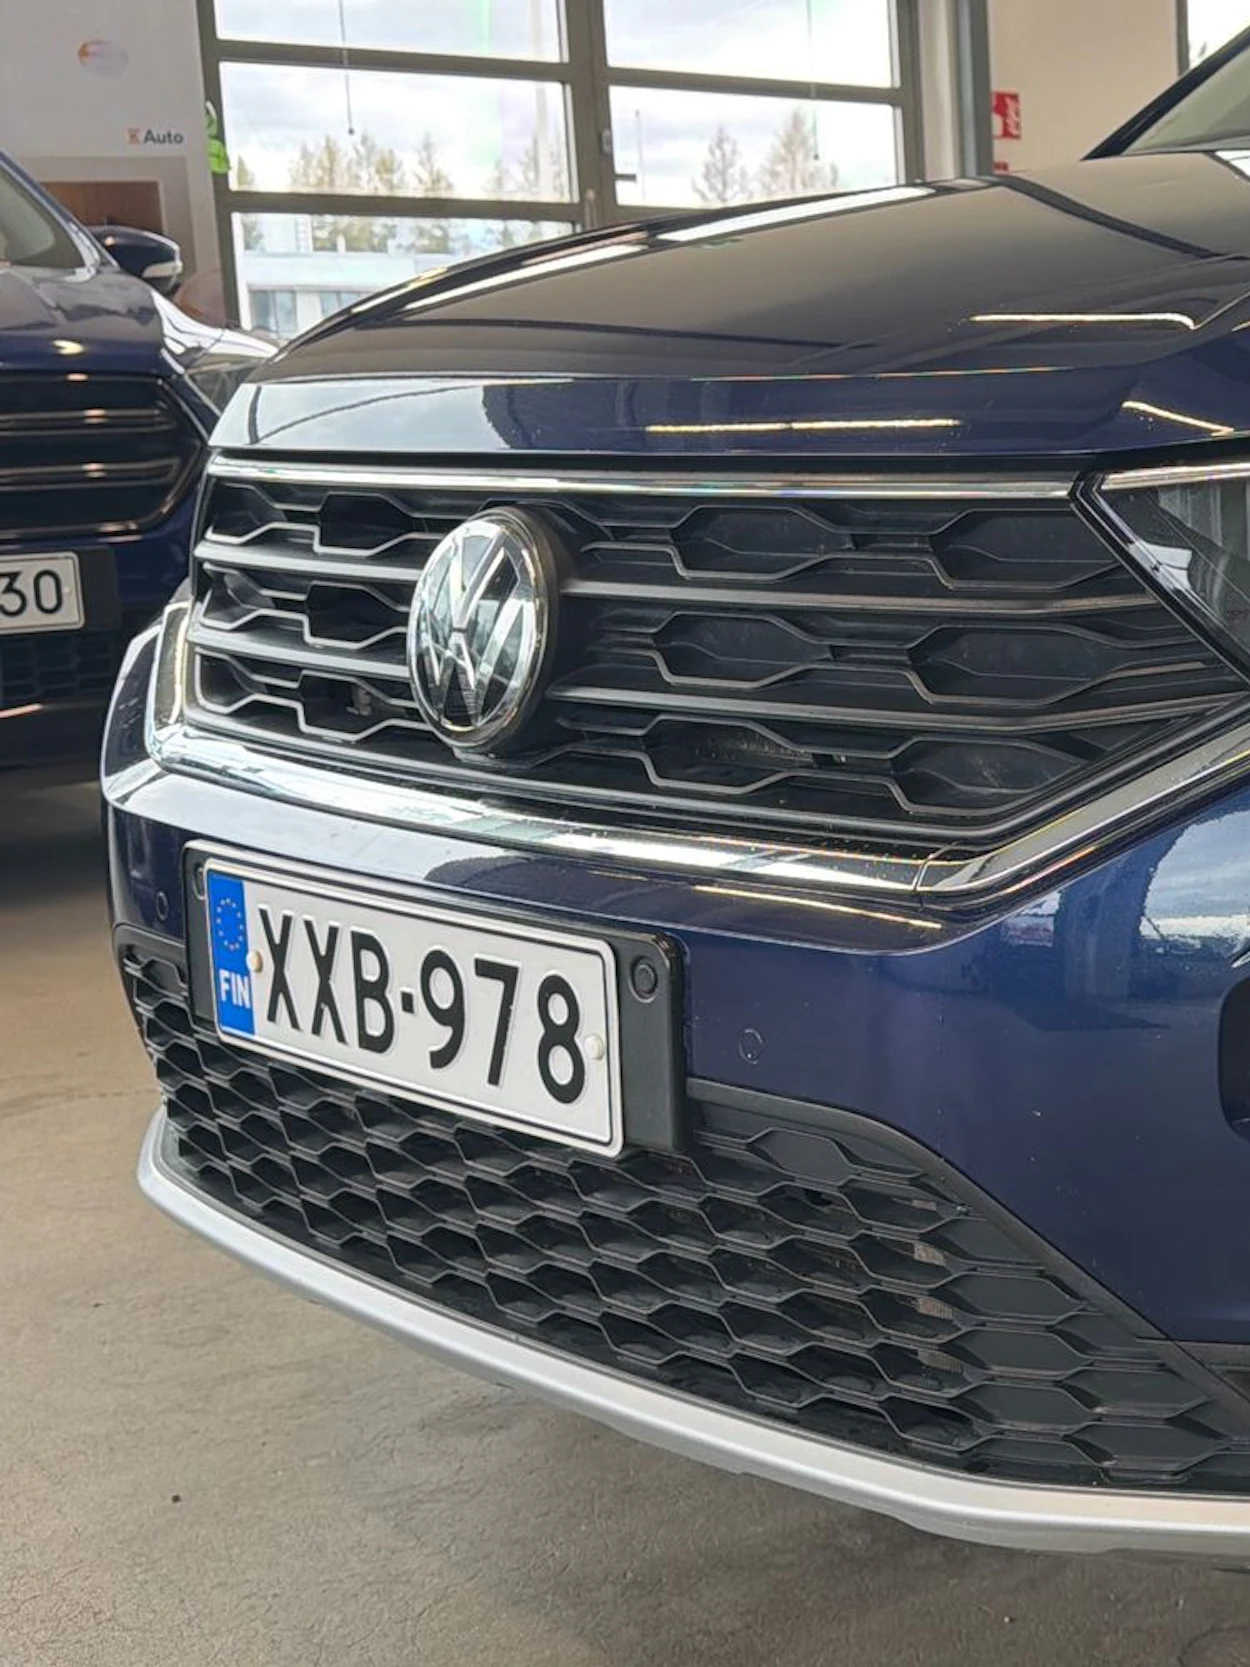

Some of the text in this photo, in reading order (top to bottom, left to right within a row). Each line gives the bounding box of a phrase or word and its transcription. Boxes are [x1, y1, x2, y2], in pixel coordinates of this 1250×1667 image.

[144, 129, 184, 145] Auto
[0, 568, 63, 617] 30
[219, 969, 251, 1009] FIN
[258, 907, 586, 1105] XXB-978
